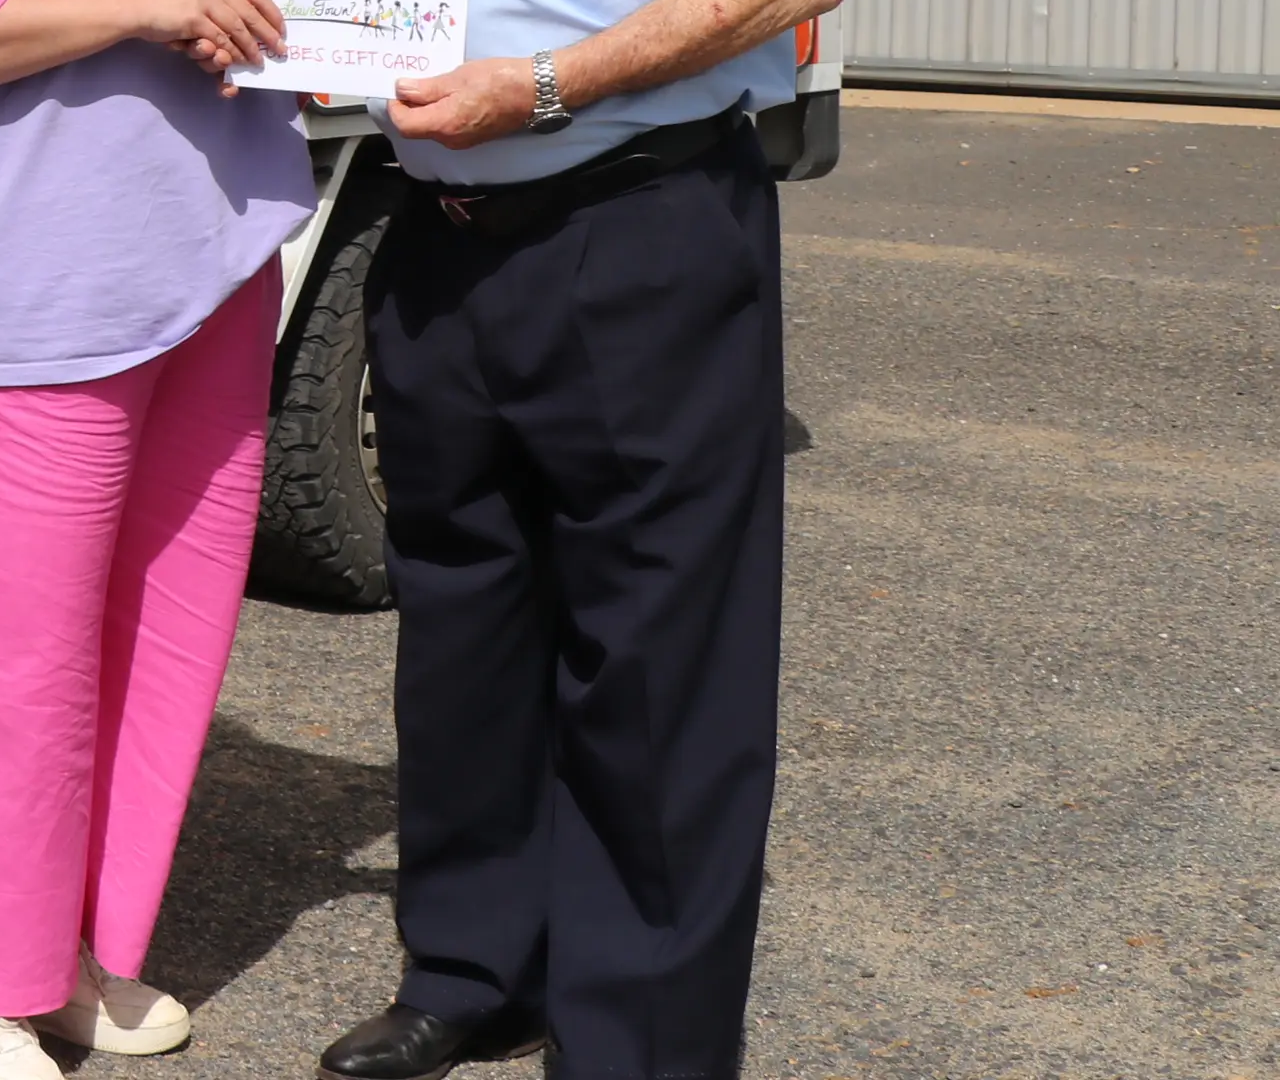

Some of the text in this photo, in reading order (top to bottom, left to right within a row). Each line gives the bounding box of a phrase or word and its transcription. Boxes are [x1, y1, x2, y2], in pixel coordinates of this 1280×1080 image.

[258, 42, 430, 71] FOBES GIFT CARD
